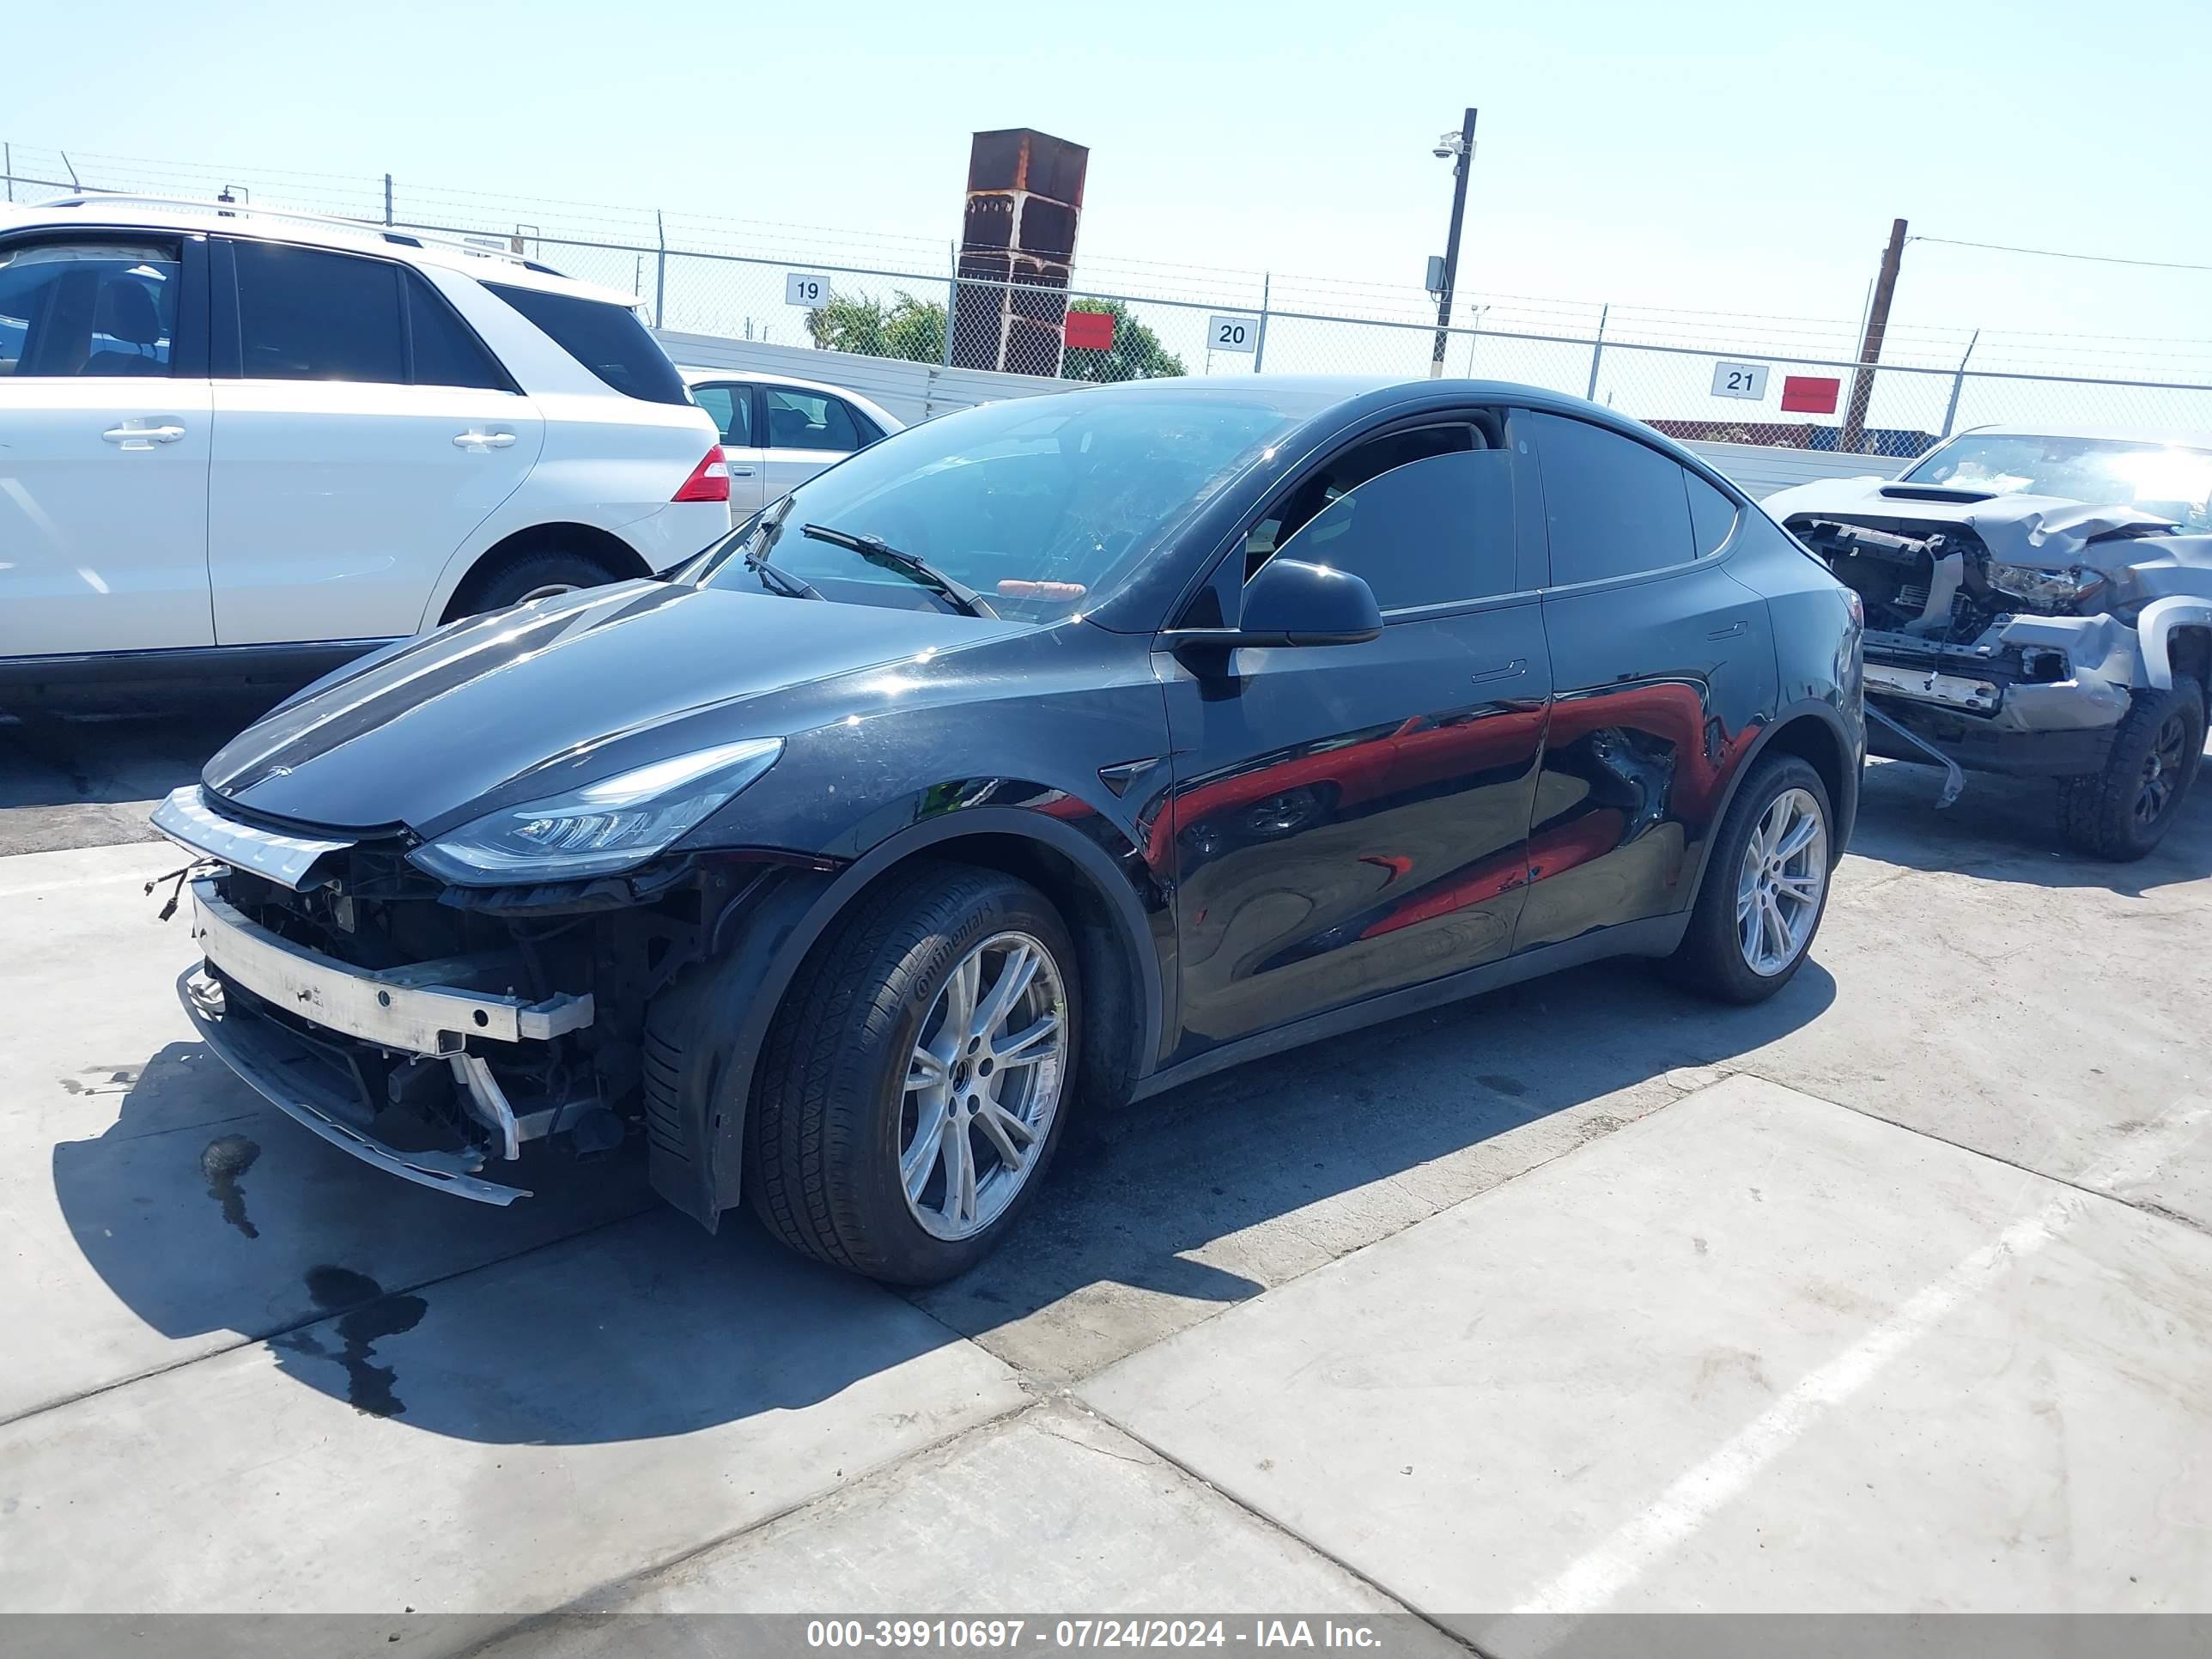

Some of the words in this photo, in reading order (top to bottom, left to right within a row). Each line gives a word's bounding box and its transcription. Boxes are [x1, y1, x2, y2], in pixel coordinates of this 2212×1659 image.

[798, 282, 818, 300] 19
[1219, 325, 1245, 344] 20
[1727, 372, 1753, 392] 21
[914, 907, 984, 1002] Continental
